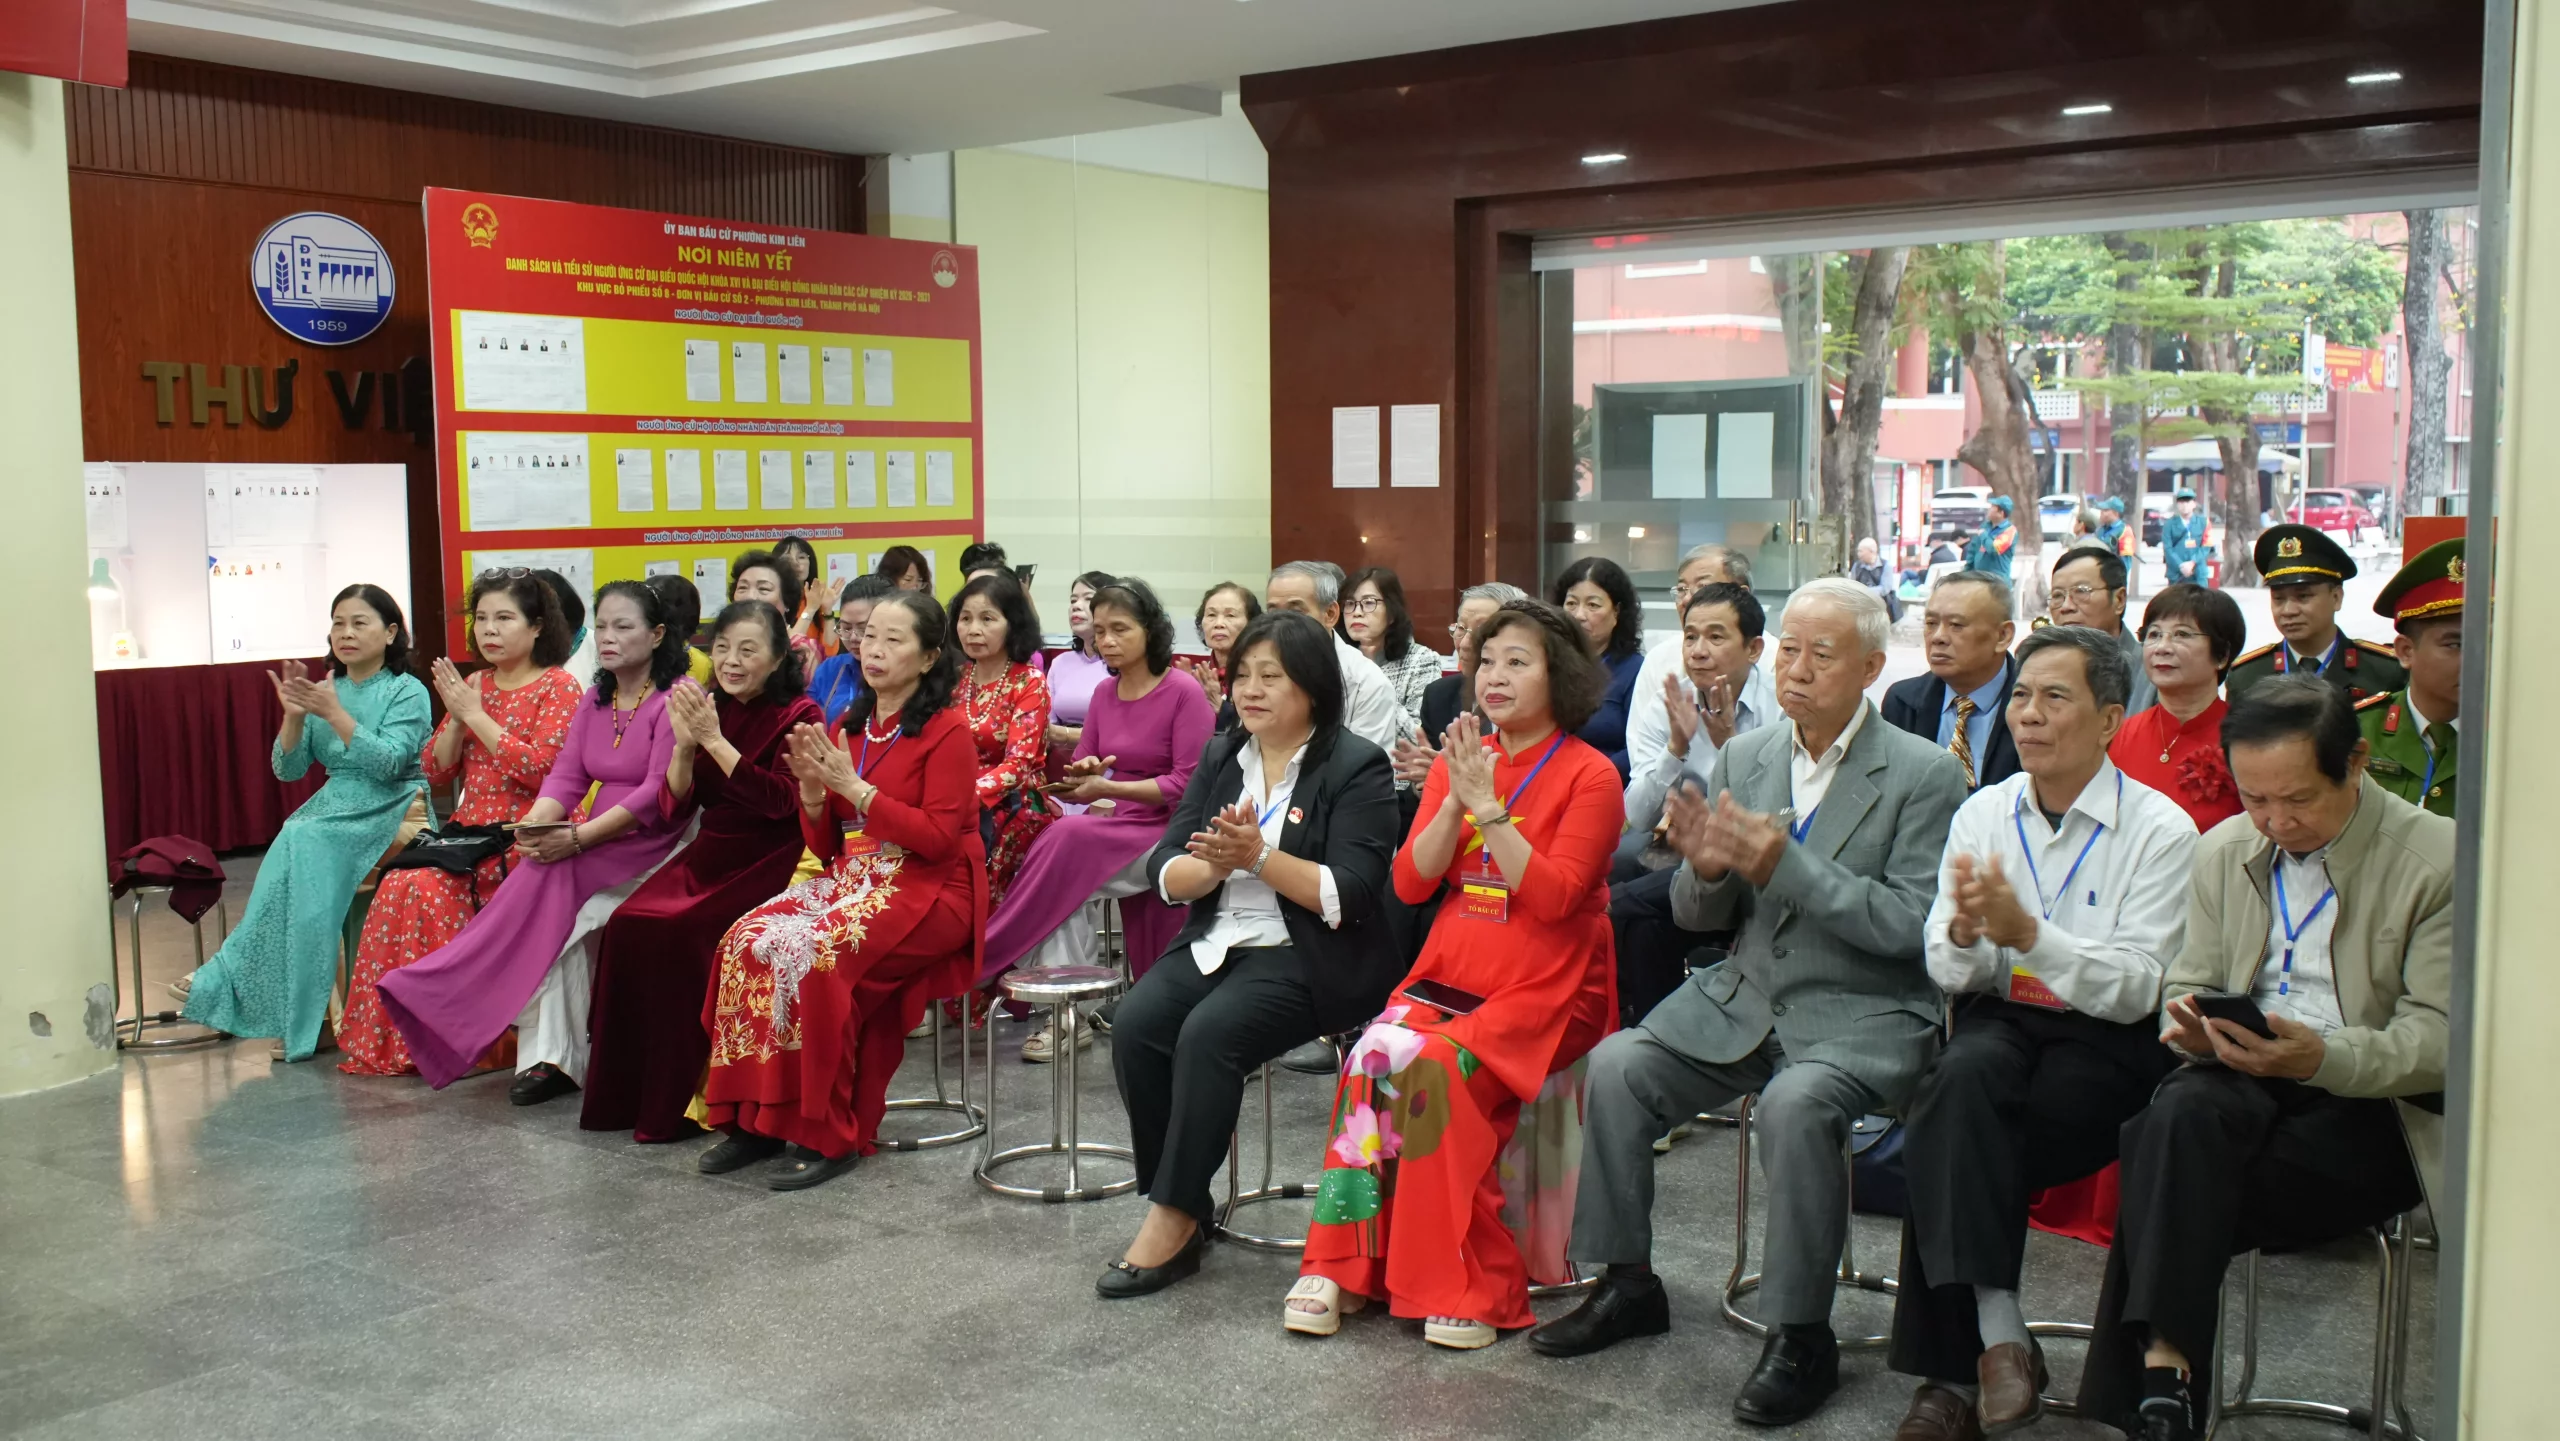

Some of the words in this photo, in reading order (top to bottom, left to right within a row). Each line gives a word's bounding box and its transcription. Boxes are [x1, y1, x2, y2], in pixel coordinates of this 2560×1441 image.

[664, 220, 676, 235] ỦY
[678, 225, 697, 236] BAN
[719, 227, 731, 240] CỬ
[733, 231, 767, 244] PHƯỜNG
[769, 235, 785, 245] KIM
[787, 235, 805, 247] LIÊN
[678, 245, 712, 264] NƠI
[718, 247, 760, 268] NIÊM
[765, 249, 793, 271] YẾT
[506, 257, 528, 271] DANH
[530, 258, 550, 273] SÁCH
[552, 259, 562, 274] VÀ
[564, 258, 580, 275] TIỂU
[582, 260, 592, 276] SỬ
[594, 263, 616, 278] NGƯỜI
[618, 265, 633, 280] ỨNG
[635, 265, 645, 280] CỬ
[646, 269, 658, 284] ĐẠI
[660, 267, 676, 283] BIỂU
[677, 269, 696, 284] QUỐC
[697, 272, 709, 288] HỘI
[711, 274, 728, 287] KHÓA
[730, 276, 740, 288] XVI
[742, 276, 751, 289] VÀ
[752, 278, 763, 292] ĐẠI
[780, 279, 791, 294] HỘI
[829, 282, 842, 296] DÂN
[843, 284, 855, 297] CÁC
[577, 281, 594, 292] KHU
[596, 283, 611, 296] VỰC
[614, 282, 624, 295] BỎ
[627, 284, 650, 297] PHIẾU
[652, 285, 662, 298] SỐ
[676, 289, 692, 300] ĐƠN
[694, 290, 701, 303] VỊ
[721, 290, 731, 302] CỬ
[732, 292, 742, 304] SỐ
[744, 295, 749, 304] 2
[755, 295, 784, 306] PHƯỜNG
[786, 297, 799, 307] KIM
[858, 302, 867, 312] HÀ
[869, 303, 880, 314] NỘI
[307, 319, 347, 332] 1959
[675, 308, 700, 319] NGƯỜI
[702, 309, 719, 320] ỨNG
[721, 310, 733, 321] CỬ
[734, 314, 747, 324] ĐẠI
[748, 311, 764, 324] BIỂU
[765, 313, 788, 325] QUỐC
[789, 315, 803, 327] HỘI
[141, 358, 299, 428] THƯ
[637, 419, 664, 430] NGƯỜI
[665, 419, 683, 431] ỨNG
[684, 419, 696, 431] CỬ
[697, 420, 711, 433] HỘI
[713, 419, 736, 431] ĐỒNG
[737, 421, 759, 432] NHÂN
[760, 421, 776, 432] DÂN
[778, 422, 801, 433] THÀNH
[803, 421, 819, 433] PHỐ
[820, 422, 830, 433] HÀ
[831, 422, 844, 435] NỘI
[644, 531, 671, 542] NGƯỜI
[672, 530, 690, 541] ỨNG
[691, 529, 703, 541] CỬ
[704, 529, 718, 543] HỘI
[720, 528, 743, 540] ĐỒNG
[744, 529, 765, 540] NHÂN
[766, 528, 782, 539] DÂN
[815, 528, 828, 538] KIM
[829, 526, 843, 538] LIÊN
[1468, 904, 1477, 912] TỔ
